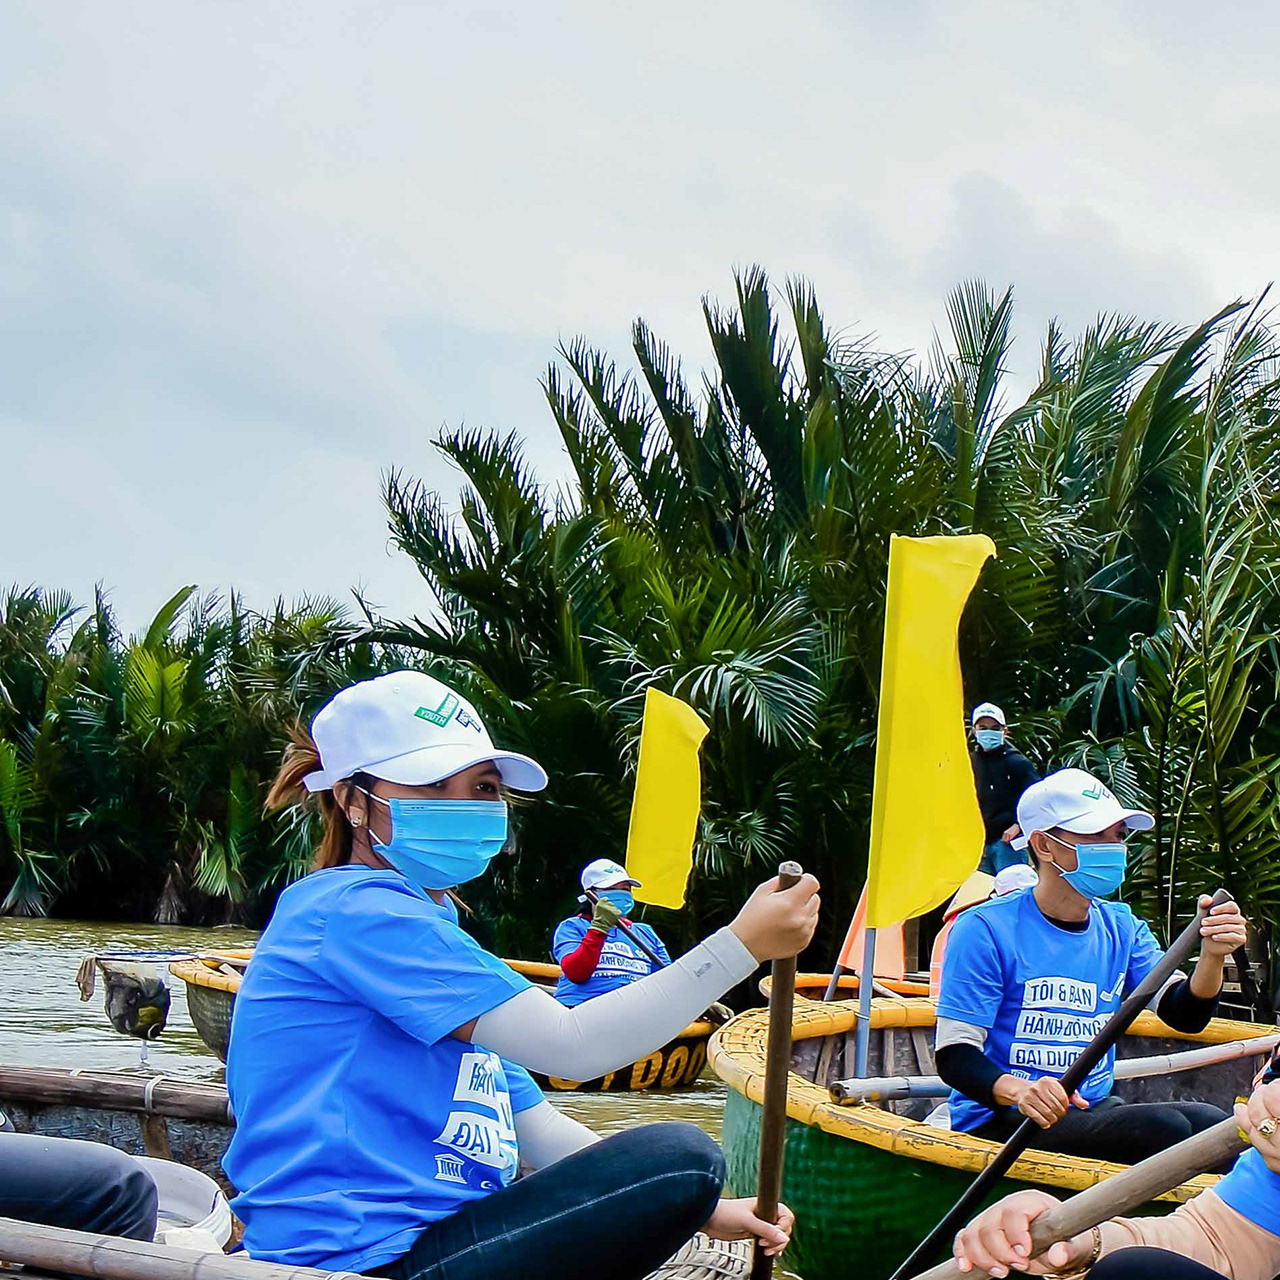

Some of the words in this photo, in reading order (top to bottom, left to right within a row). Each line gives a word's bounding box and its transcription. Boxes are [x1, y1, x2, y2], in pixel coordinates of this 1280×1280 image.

[1031, 980, 1054, 1001] TÔI
[1058, 984, 1067, 1001] &
[1069, 985, 1092, 1008] BẠN
[1022, 1013, 1063, 1036] HÀNH
[1016, 1049, 1041, 1067] ĐẠI
[450, 1122, 491, 1157] ĐẠI
